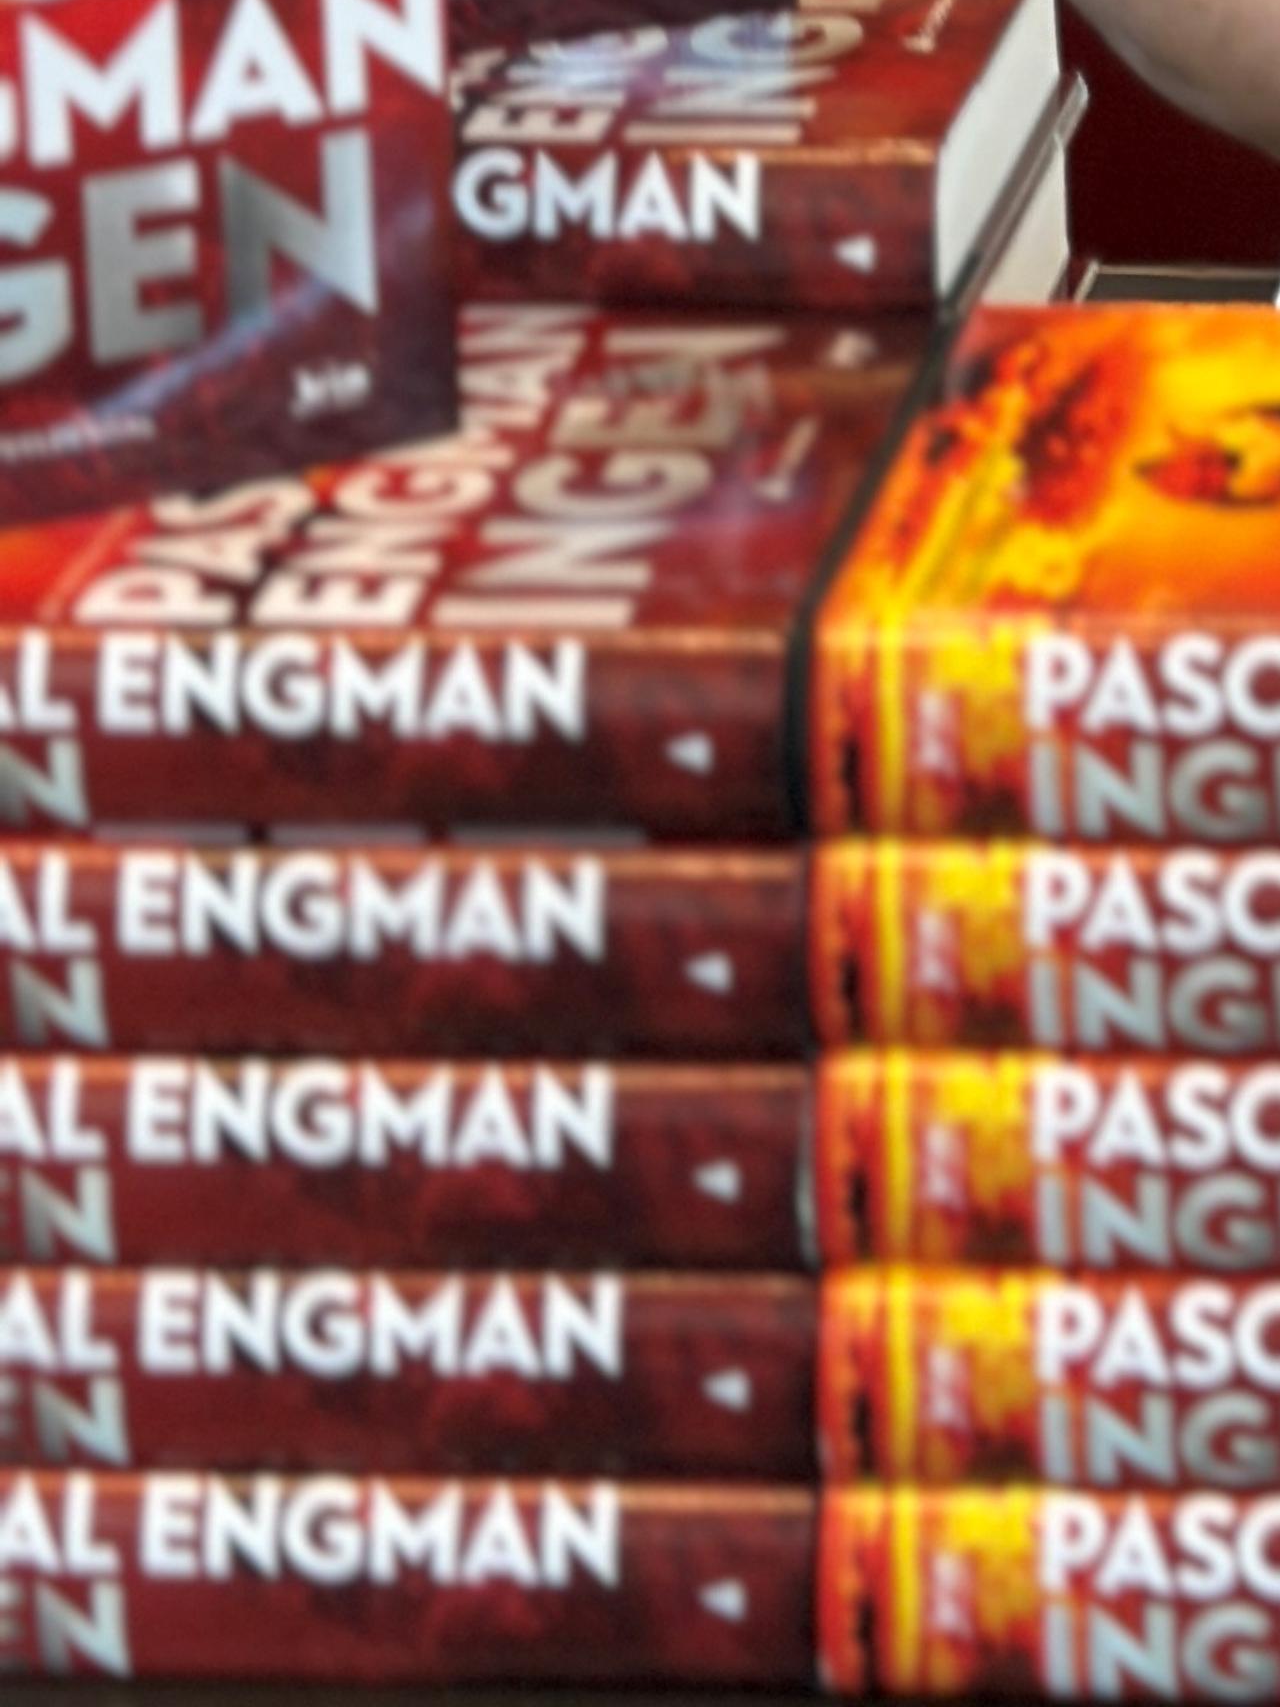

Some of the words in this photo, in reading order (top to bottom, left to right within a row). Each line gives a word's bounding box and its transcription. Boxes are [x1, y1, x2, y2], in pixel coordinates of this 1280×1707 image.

[453, 146, 761, 243] GMAN
[432, 327, 786, 627] INGEN
[97, 629, 586, 743] ENGMAN
[115, 849, 606, 963] ENGMAN
[127, 1057, 613, 1170] ENGMAN
[138, 1267, 625, 1381] ENGMAN
[138, 1472, 623, 1587] ENGMAN
